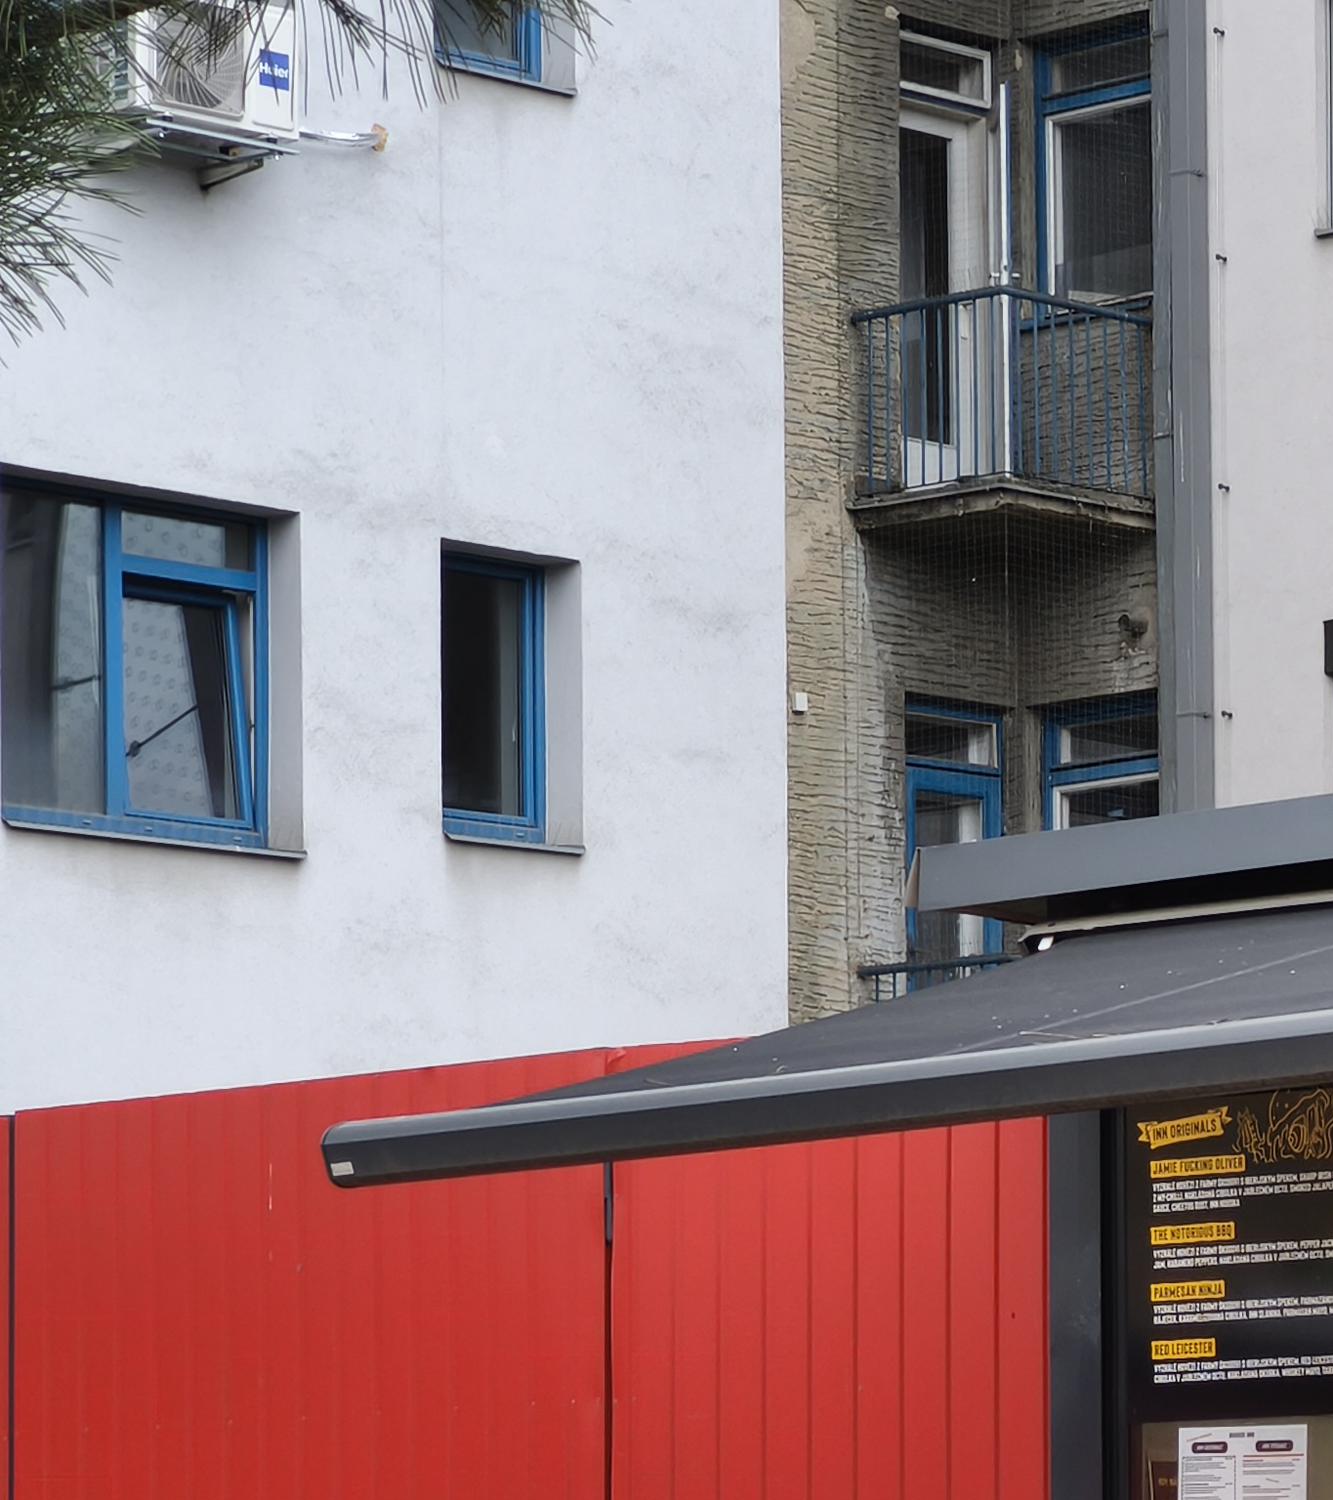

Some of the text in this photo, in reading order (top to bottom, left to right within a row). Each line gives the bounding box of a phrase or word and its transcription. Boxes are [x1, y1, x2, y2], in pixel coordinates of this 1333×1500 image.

[1153, 1119, 1217, 1141] INN ORIGINALS
[1153, 1156, 1243, 1174] JAMIE FUCKING OLIVER
[1153, 1229, 1168, 1241] THE
[1170, 1226, 1213, 1240] NOTORIOUS
[1154, 1283, 1223, 1300] PARMESAN NINJA
[1154, 1341, 1213, 1356] RED LEICESTER
